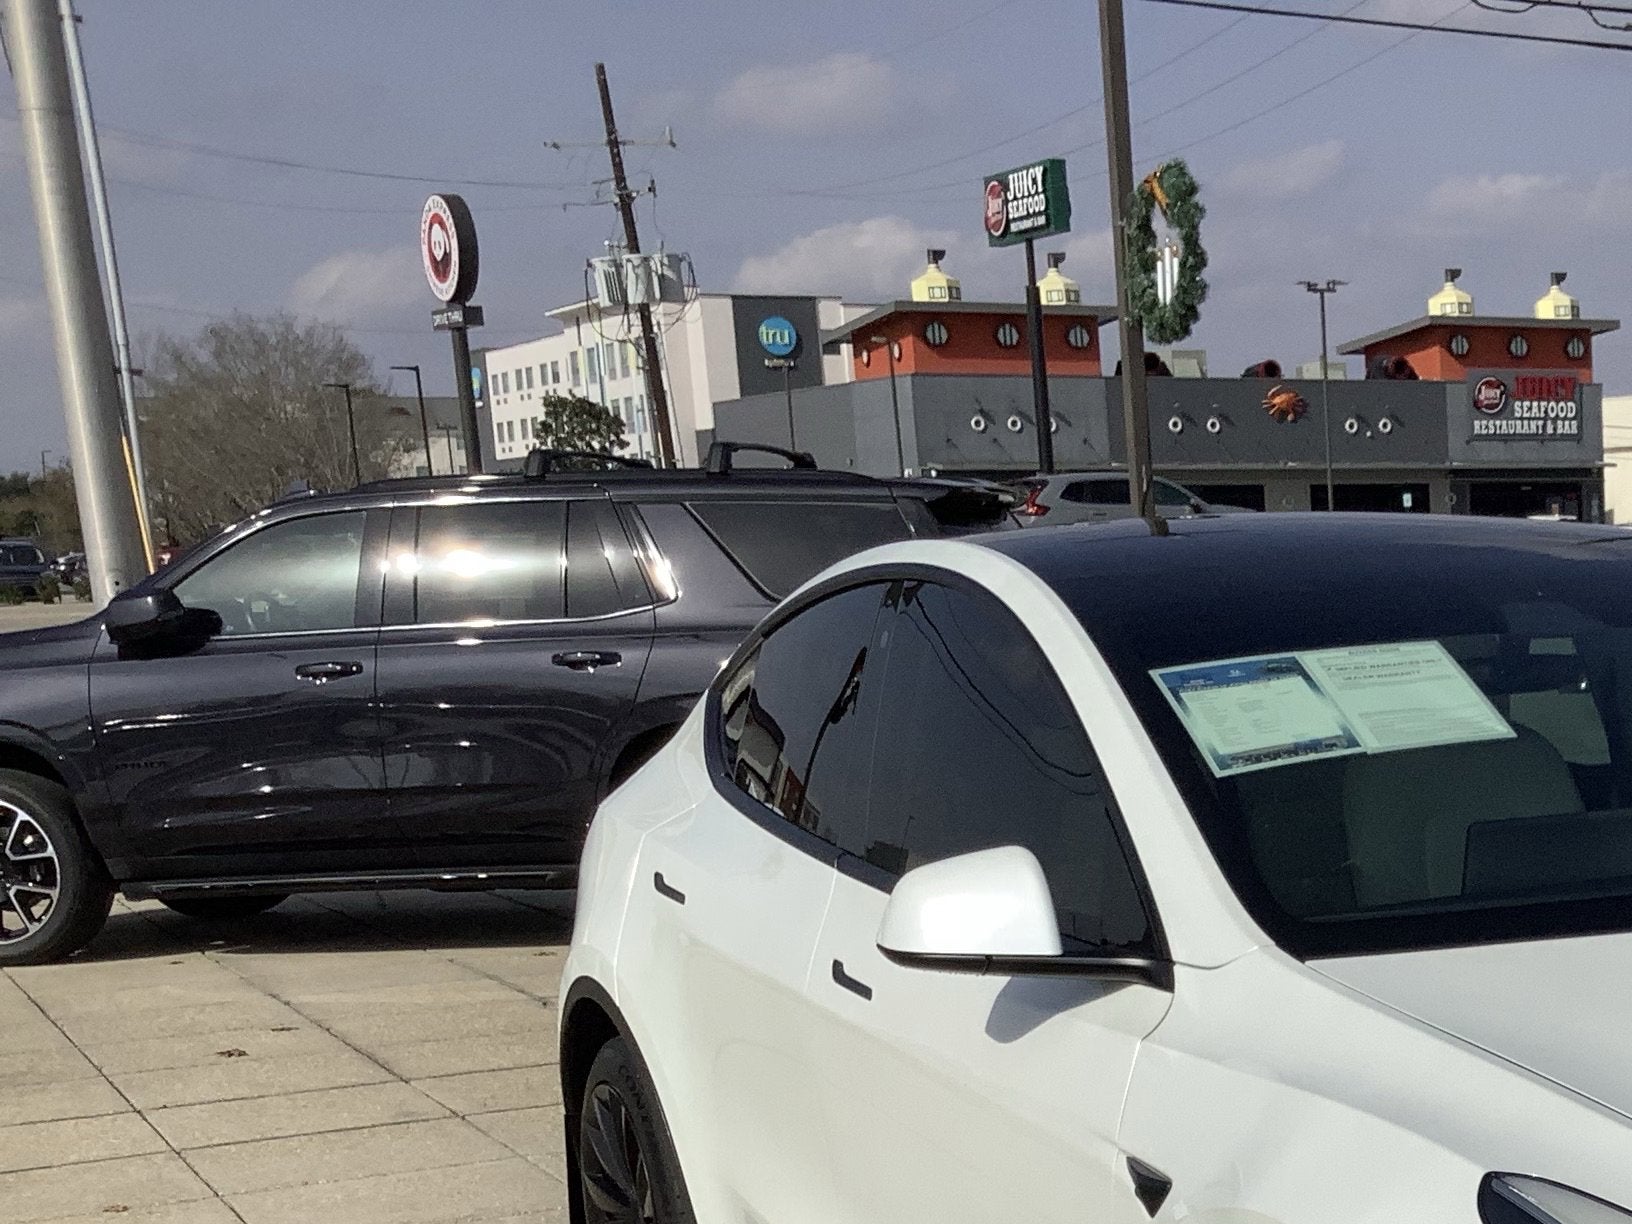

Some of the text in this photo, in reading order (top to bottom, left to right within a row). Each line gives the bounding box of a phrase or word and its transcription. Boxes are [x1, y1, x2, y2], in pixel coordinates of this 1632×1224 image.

[1006, 165, 1044, 200] JUICY
[1008, 193, 1046, 219] SEAFOOD
[759, 324, 790, 345] tru
[1510, 376, 1576, 402] JUICY
[1514, 401, 1577, 418] SEAFOOD
[1473, 420, 1579, 435] RESTAURANT & BAR
